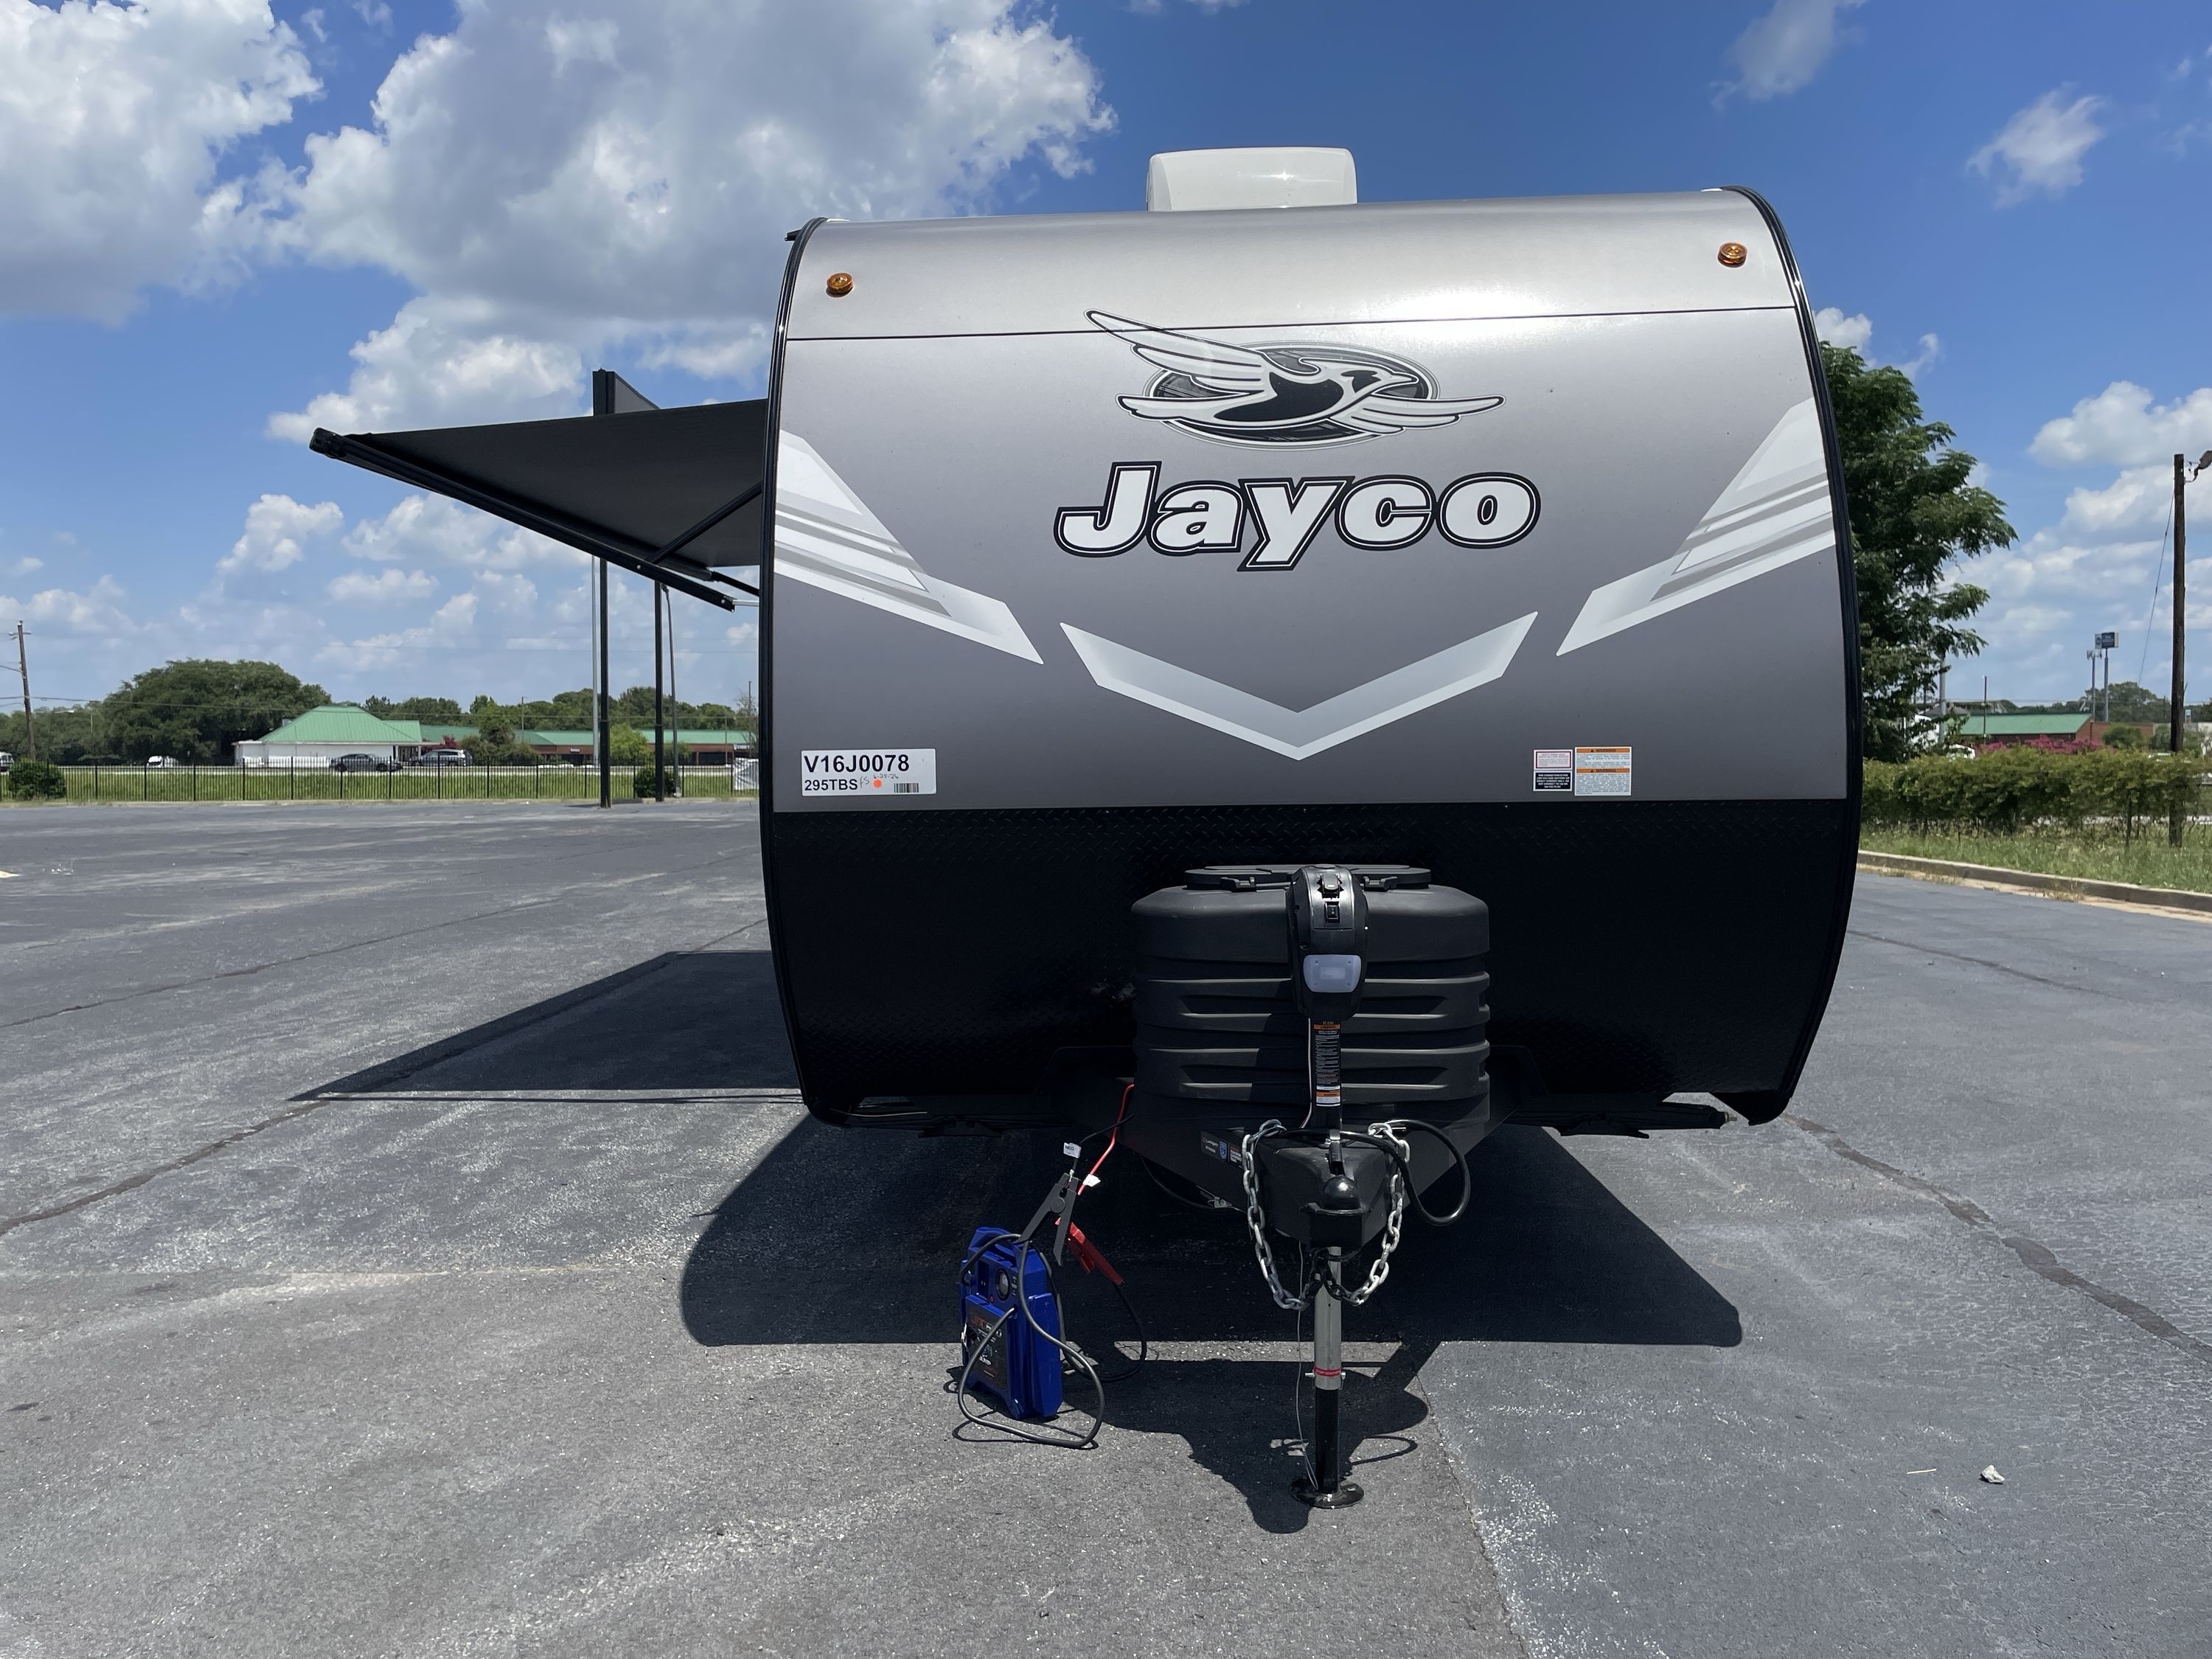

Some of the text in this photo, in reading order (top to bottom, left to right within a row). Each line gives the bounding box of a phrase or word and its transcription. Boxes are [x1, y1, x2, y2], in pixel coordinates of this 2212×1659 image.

[1053, 461, 1541, 571] Jayco
[804, 754, 910, 773] V16J0078
[804, 779, 858, 791] 295TBS
